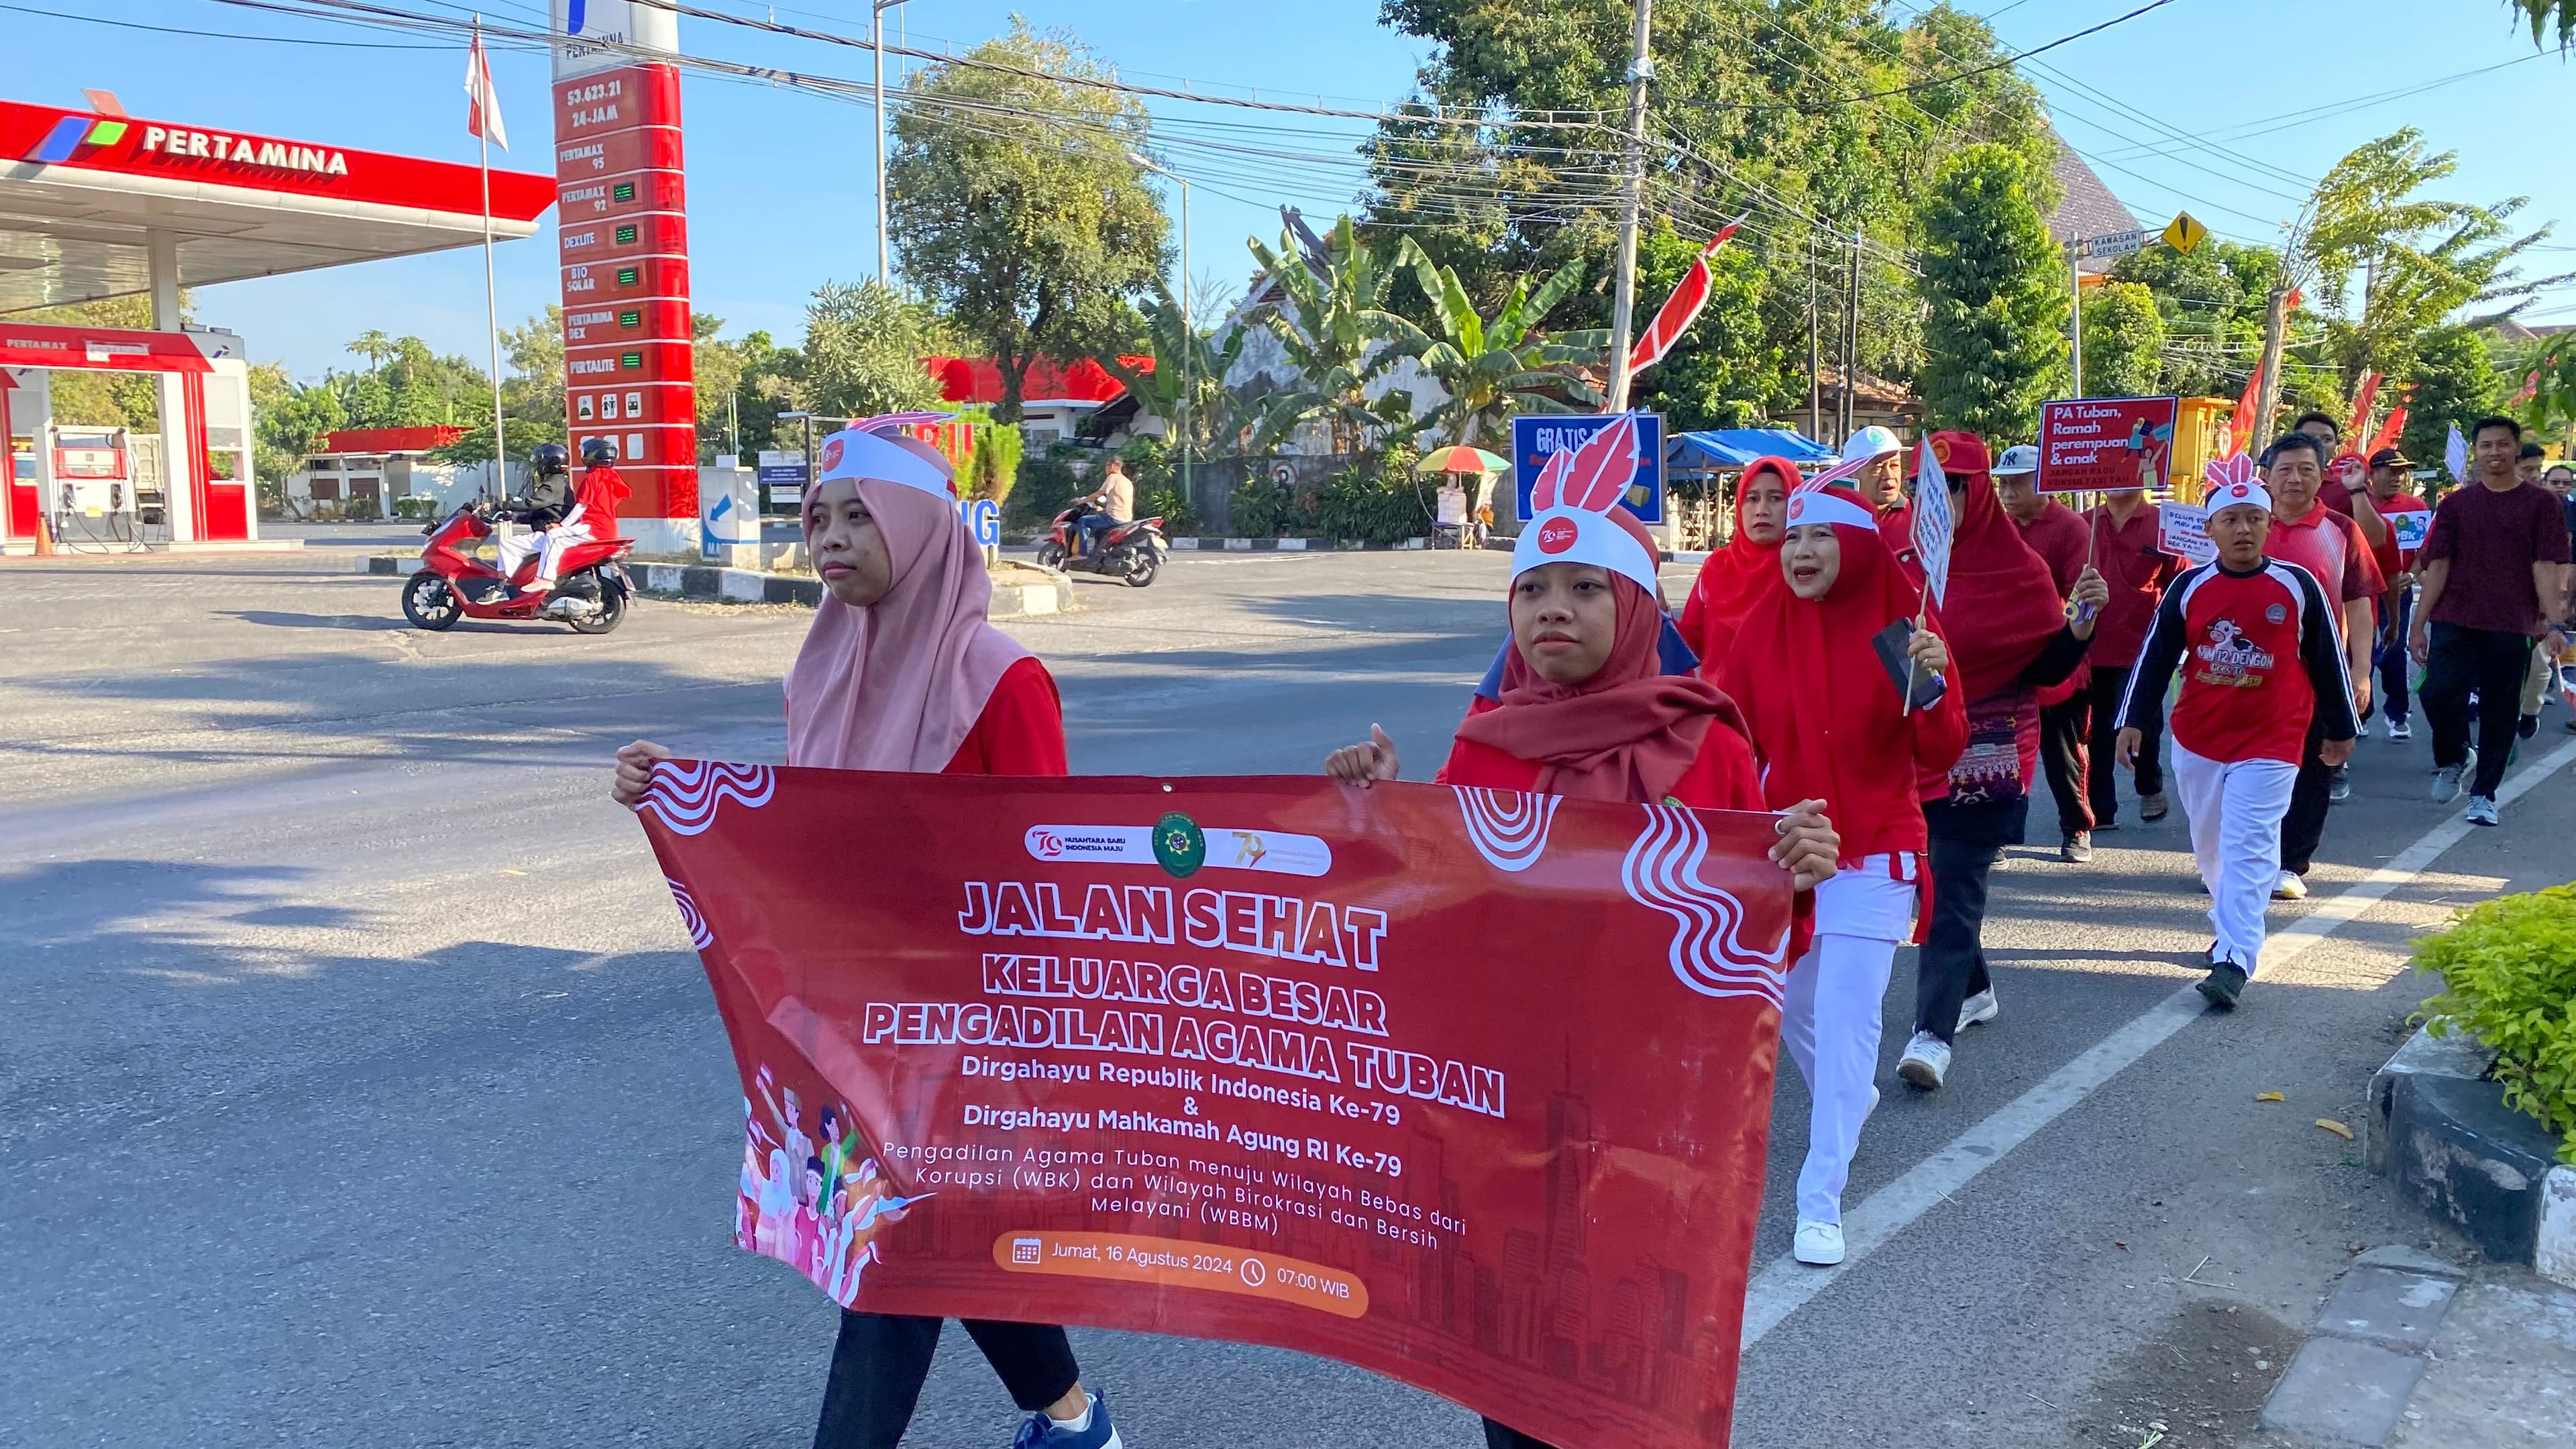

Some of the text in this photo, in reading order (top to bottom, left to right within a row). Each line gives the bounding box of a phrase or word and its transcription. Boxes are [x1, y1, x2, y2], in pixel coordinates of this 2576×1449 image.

[568, 80, 621, 106] 53.623.21
[572, 105, 619, 127] 24-JAM
[143, 126, 348, 176] PERTAMINA
[560, 143, 604, 162] PERTAMAX
[592, 157, 604, 169] 95
[562, 185, 605, 203] PERTAMAX
[594, 199, 606, 211] 92
[564, 231, 596, 249] DEXLITE
[2095, 233, 2137, 246] KAWASAN
[2097, 244, 2137, 256] SEKOLAH
[571, 266, 588, 278] BIO
[567, 278, 595, 292] SOLAR
[569, 328, 586, 339] DEX
[570, 359, 615, 374] PERTALITE
[2054, 405, 2122, 419] PA Tuban,
[2053, 421, 2101, 435] Ramah
[1536, 427, 1588, 453] GRATIS
[2051, 438, 2129, 453] perempuan
[2050, 453, 2098, 466] & anak
[958, 881, 1388, 972] JALAN SEHAT
[983, 953, 1389, 1037] KELUARGA BESAR
[863, 1003, 1505, 1118] PENGADILAN AGAMA TUBAN
[962, 1055, 1401, 1126] Dirgahayu Republik Indonesia Ke-79
[1183, 1096, 1199, 1116] &
[963, 1105, 1401, 1177] Dirgahayu Mahkamah Agung RI Ke-79
[883, 1142, 1466, 1236] Pengadilan Agama Tuban menuju Wilayah Bebas dari
[916, 1167, 1438, 1250] Korupsi (WBK) dan Wilayah Birokrasi dan Bersih
[1091, 1197, 1278, 1236] Melayani (WBBM)
[1052, 1242, 1350, 1299] Jumat, 16 Agustus 2024 07:00 WIB
